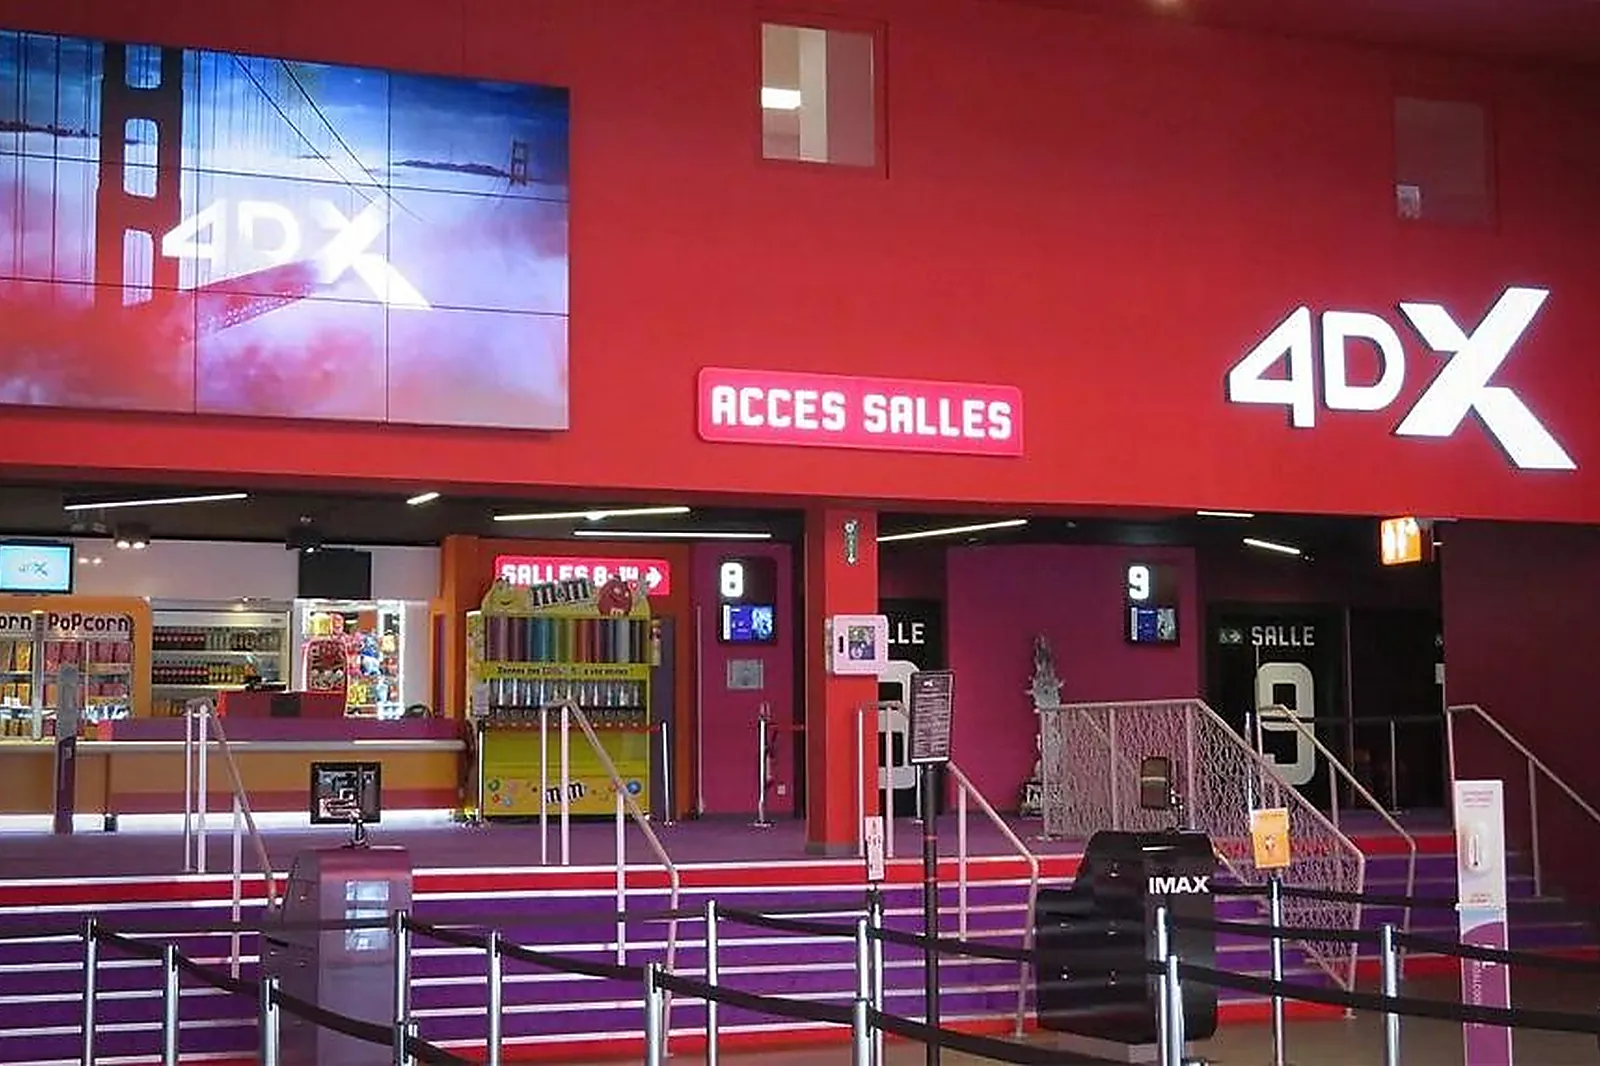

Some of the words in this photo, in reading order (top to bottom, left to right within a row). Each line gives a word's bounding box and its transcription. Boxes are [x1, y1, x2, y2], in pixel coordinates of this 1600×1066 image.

[162, 199, 432, 310] 4DX
[1226, 286, 1578, 470] 4DX
[711, 385, 846, 431] ACCES
[863, 394, 1012, 440] SALLES
[721, 562, 743, 597] 8
[1128, 566, 1149, 599] 9
[1251, 625, 1316, 646] SALLE
[1254, 661, 1316, 786] 9
[1148, 876, 1210, 895] IMAX
